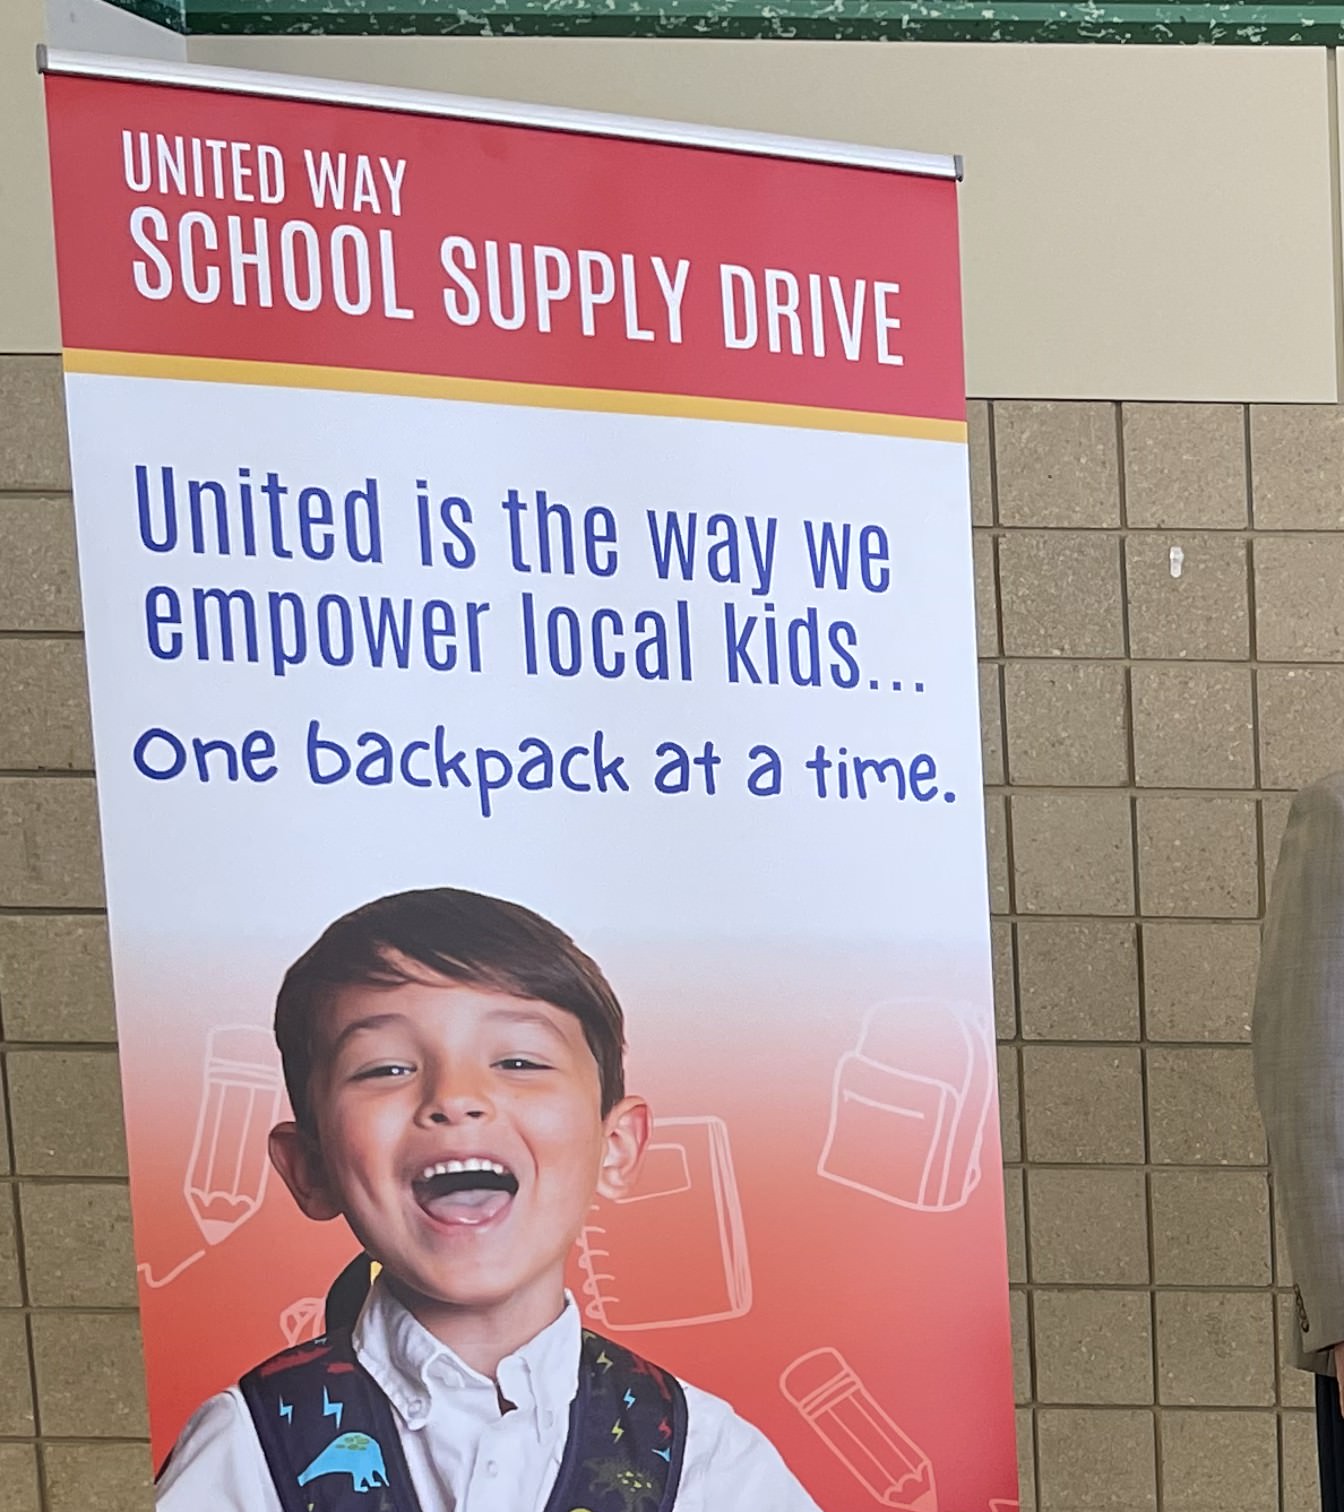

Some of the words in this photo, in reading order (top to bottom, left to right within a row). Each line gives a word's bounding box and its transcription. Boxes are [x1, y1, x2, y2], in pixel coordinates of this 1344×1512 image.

[122, 129, 285, 206] UNITED
[304, 149, 407, 217] WAY
[131, 207, 414, 320] SCHOOL
[441, 235, 691, 344] SUPPLY
[722, 264, 904, 367] DRIVE
[134, 465, 383, 565] United
[417, 480, 476, 570] is
[502, 489, 618, 578] the
[646, 510, 777, 596] way
[804, 521, 892, 593] we
[145, 583, 490, 677] empower
[522, 599, 694, 682] local
[133, 724, 279, 782] one
[306, 720, 630, 810] backpack
[655, 742, 722, 796] at
[748, 745, 785, 796] a
[806, 745, 957, 803] time.
